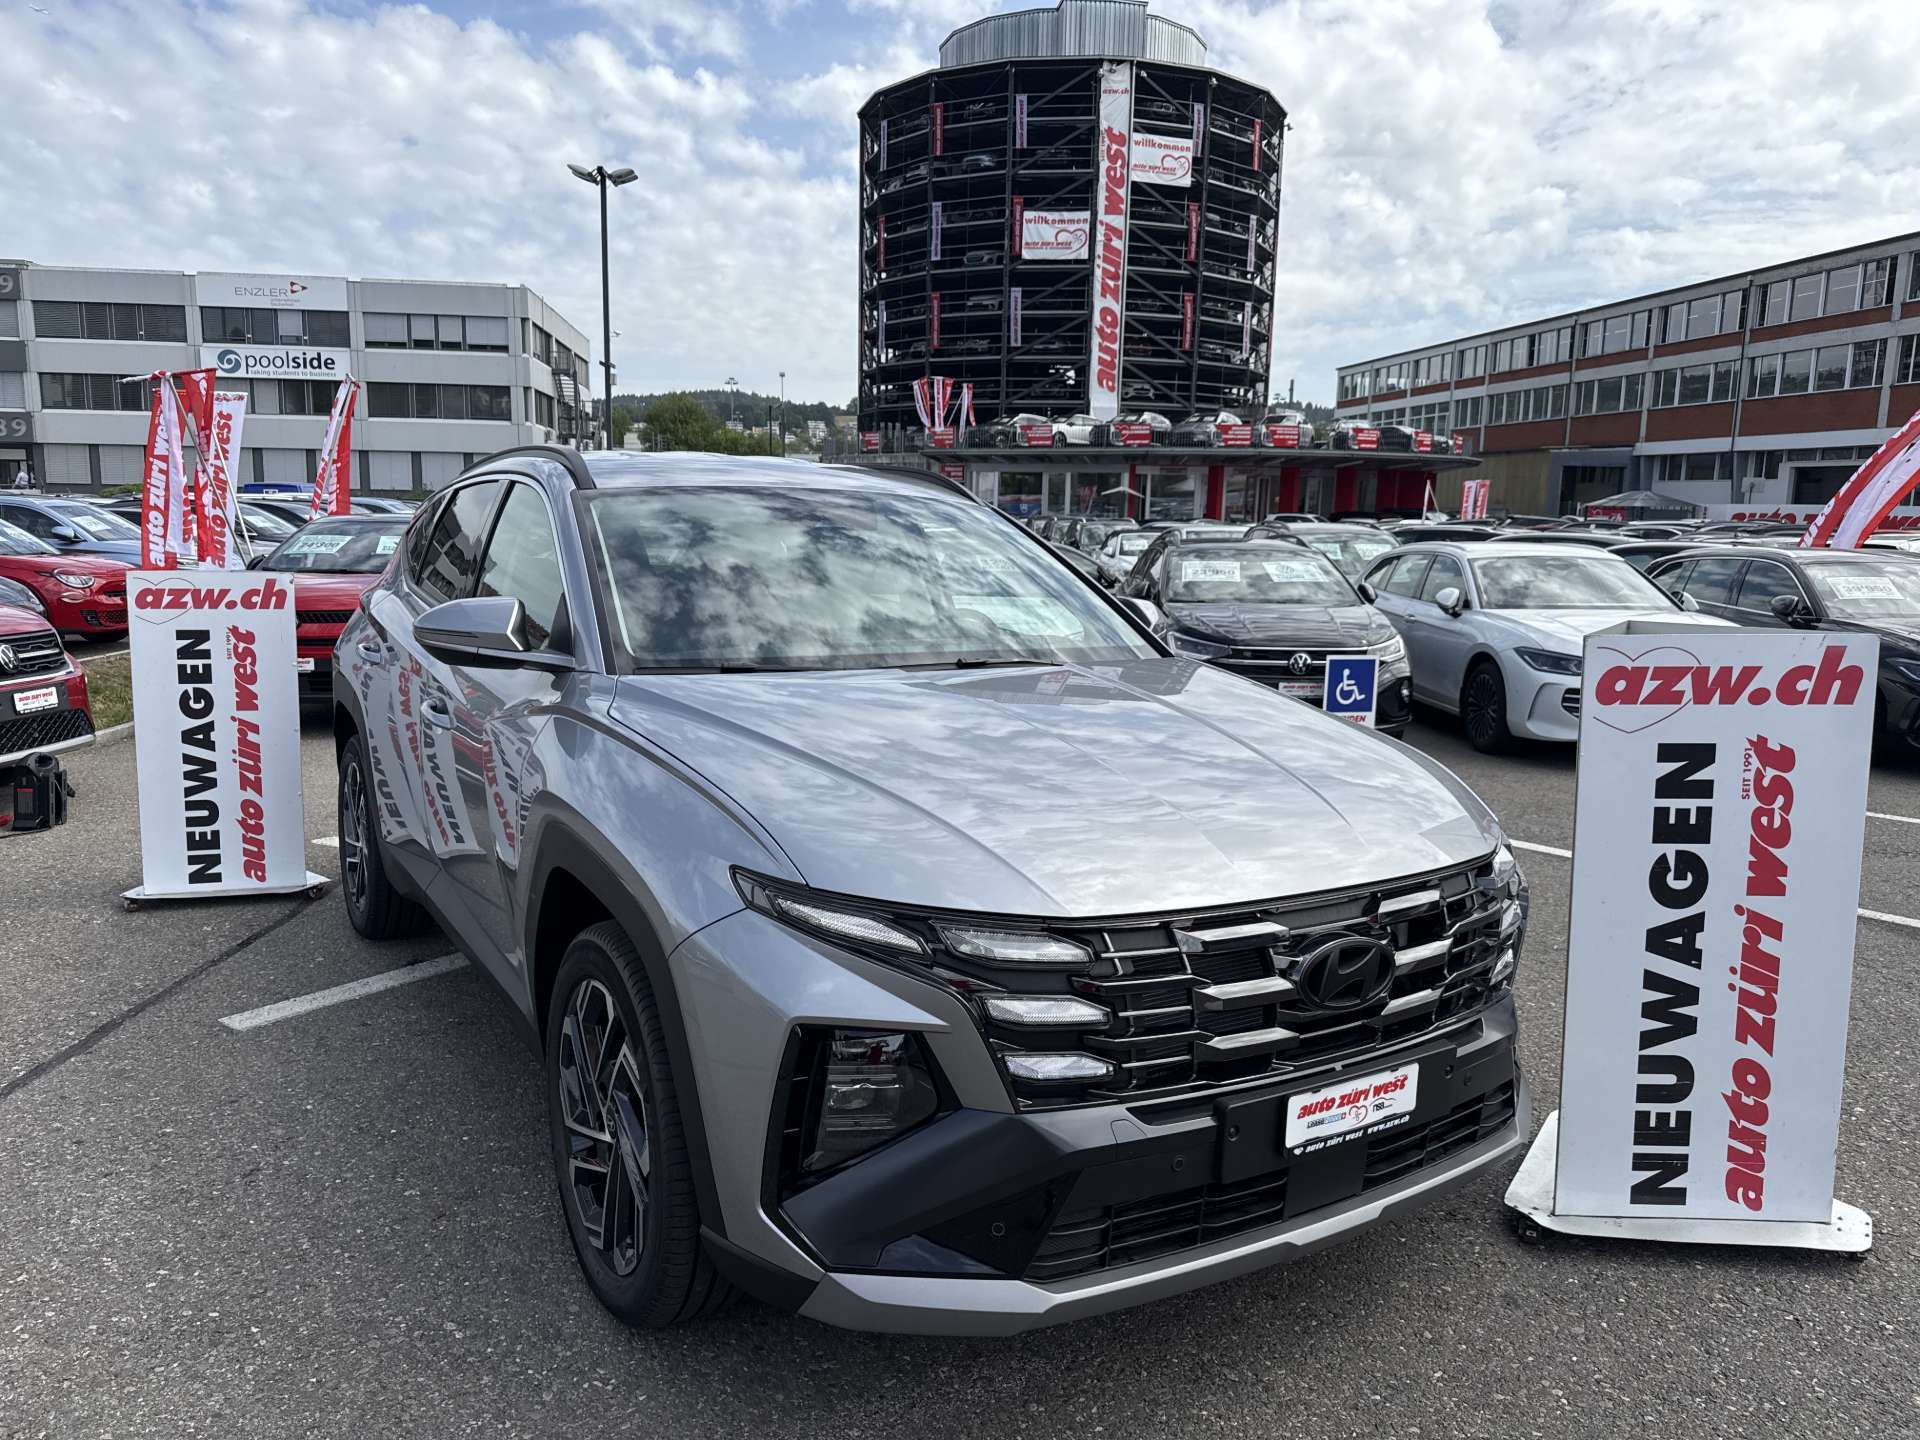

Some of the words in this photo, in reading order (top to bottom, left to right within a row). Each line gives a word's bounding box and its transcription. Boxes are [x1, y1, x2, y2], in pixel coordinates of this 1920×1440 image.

[1104, 127, 1128, 216] west
[1134, 138, 1191, 152] willkommen
[1025, 216, 1089, 225] willkommen
[1096, 220, 1123, 303] züri
[234, 287, 288, 297] ENZLER
[245, 351, 335, 374] poolside
[1096, 307, 1119, 392] auto
[153, 413, 170, 455] we
[147, 457, 168, 511] züri
[146, 511, 166, 568] auto
[135, 579, 288, 610] azw.ch
[227, 625, 258, 712] west
[1595, 646, 1864, 706] azw.ch
[175, 629, 222, 884] NEUWAGEN
[231, 716, 263, 798] züri
[1743, 747, 1753, 773] 1991
[1741, 777, 1752, 800] SEIT
[1745, 734, 1796, 897] west
[235, 798, 267, 883] auto
[1629, 742, 1717, 1206] NEUWAGEN
[1727, 904, 1784, 1058] züri
[1297, 1096, 1337, 1119] auto
[1336, 1084, 1373, 1109] züri
[1372, 1074, 1408, 1098] west
[1305, 1140, 1325, 1153] auto
[1345, 1130, 1364, 1143] west
[1721, 1057, 1772, 1212] auto
